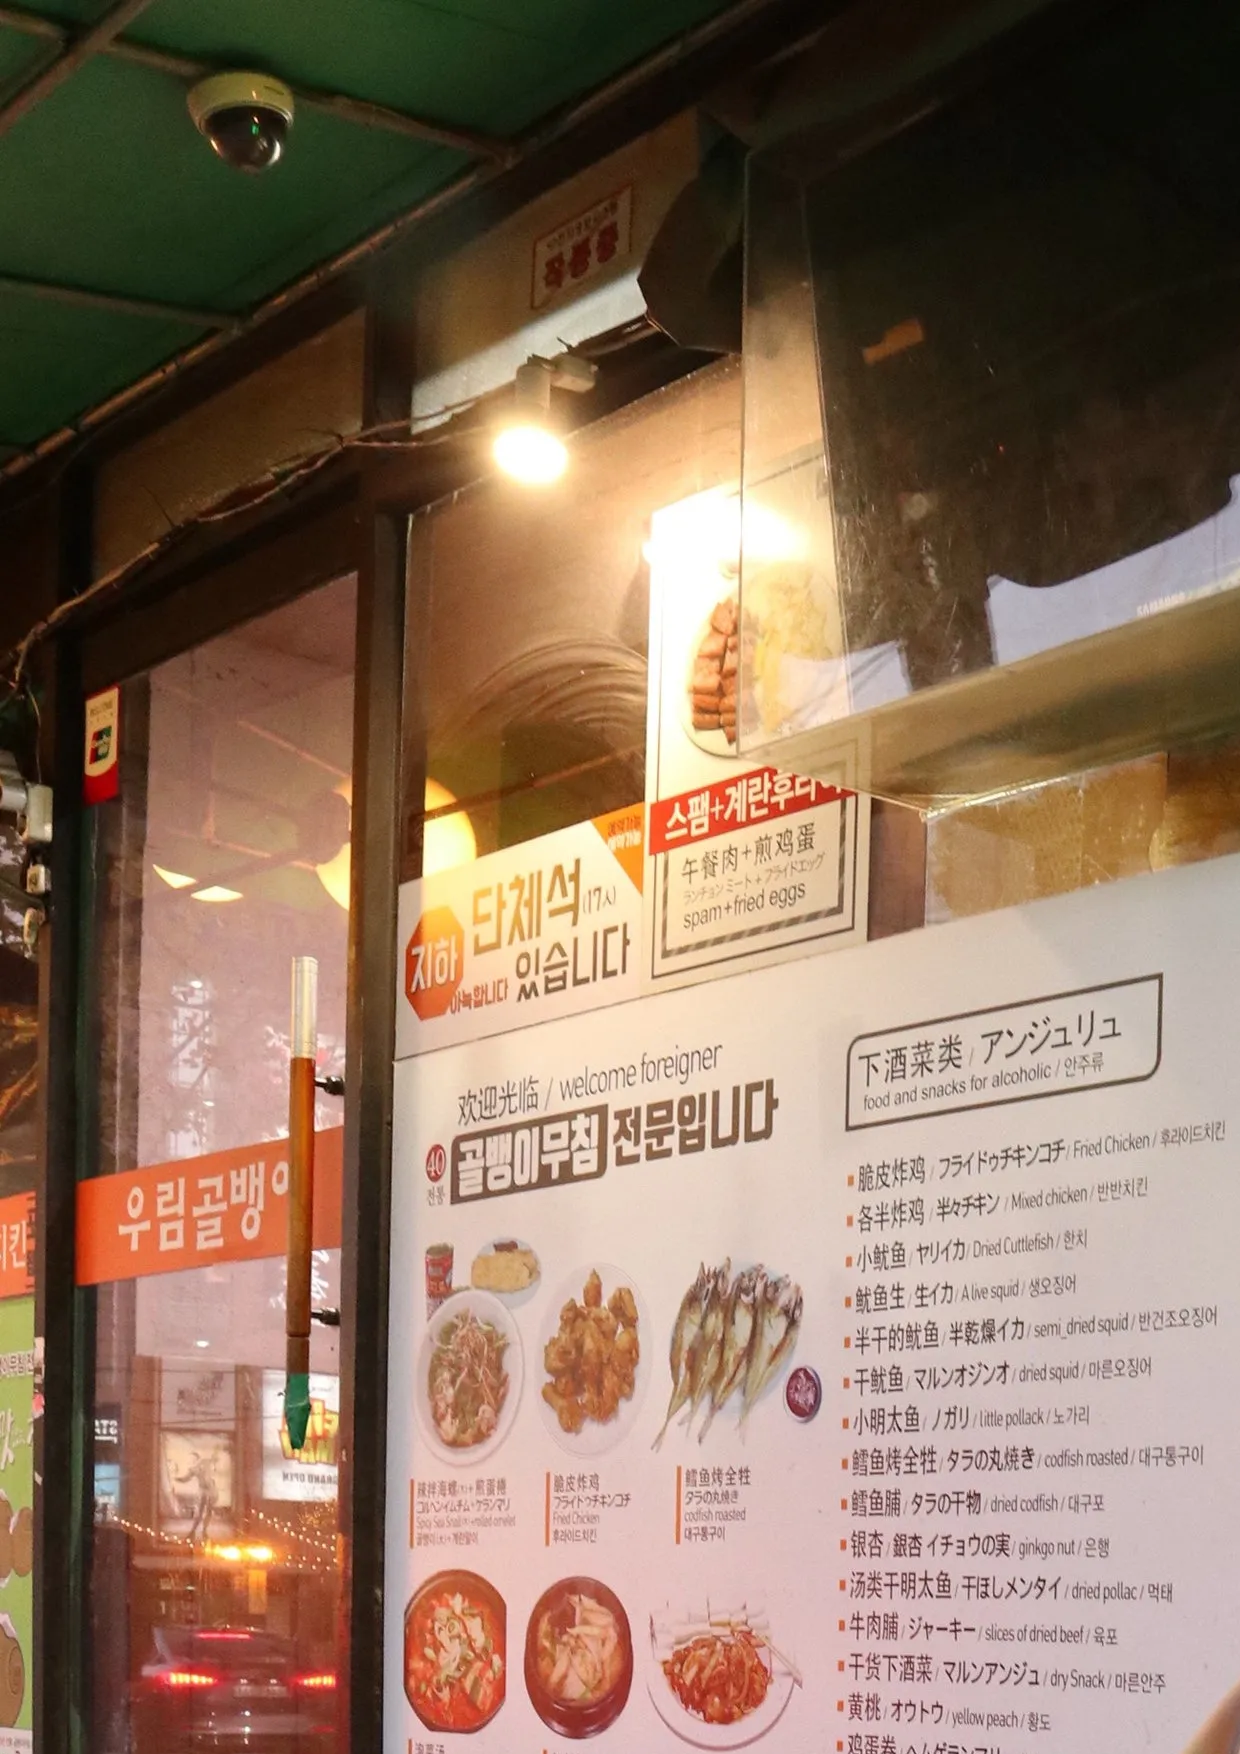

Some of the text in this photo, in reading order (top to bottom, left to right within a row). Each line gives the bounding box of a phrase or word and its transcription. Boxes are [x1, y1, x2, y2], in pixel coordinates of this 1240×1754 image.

[682, 822, 815, 884] 午餐肉+煎鸡蛋
[473, 858, 580, 957] 단체석
[683, 883, 806, 932] spam+fried eggs
[411, 936, 458, 993] 지하
[515, 922, 631, 1002] 있습니다
[858, 1010, 1122, 1087] 下酒菜类 アンジュリュ
[458, 1044, 723, 1126] 欢迎光临 welcome foreigner
[863, 1051, 1105, 1112] food and snacks for alcoholic 안주류
[458, 1079, 779, 1198] 골뱅이무침 전문입니다
[427, 1150, 445, 1178] 40
[857, 1133, 1150, 1192] 脆皮炸鸡 フライドゥチキンコチ Fried Chicken
[857, 1186, 1088, 1234] 各半炸鸡 半々チキン Mixed chicken
[856, 1228, 1088, 1273] 小鱿鱼 ヤリイカ Dried Cuttlefish 한치
[855, 1278, 1019, 1314] 鱿鱼生 生イカ squid
[855, 1312, 1129, 1355] 半干的鱿鱼 半乾燥イカ squid
[854, 1356, 1152, 1396] 干鱿鱼 マルンオジンオ dried squid 마른오징어
[853, 1404, 1090, 1436] 小明太鱼 ノガリ pollack 노가리
[947, 1444, 1204, 1472] タラの丸焼き codfish roasted 대구통구이
[851, 1488, 1105, 1517] 鳕鱼脯 タラの干物 dried codfish 대구포
[851, 1529, 1110, 1560] 银杏 イチョウの実 ginkgo nut 은행
[849, 1570, 1137, 1604] 汤类干明太鱼 干ほしメンタイ dried pollac
[849, 1611, 1085, 1644] 牛肉脯 ジャーキー slices of dried beef
[849, 1652, 1166, 1694] 干货下酒菜 マルンアンジュ dry Snack 마른안주
[848, 1692, 1018, 1731] 黄桃 オウトウ yellow peach
